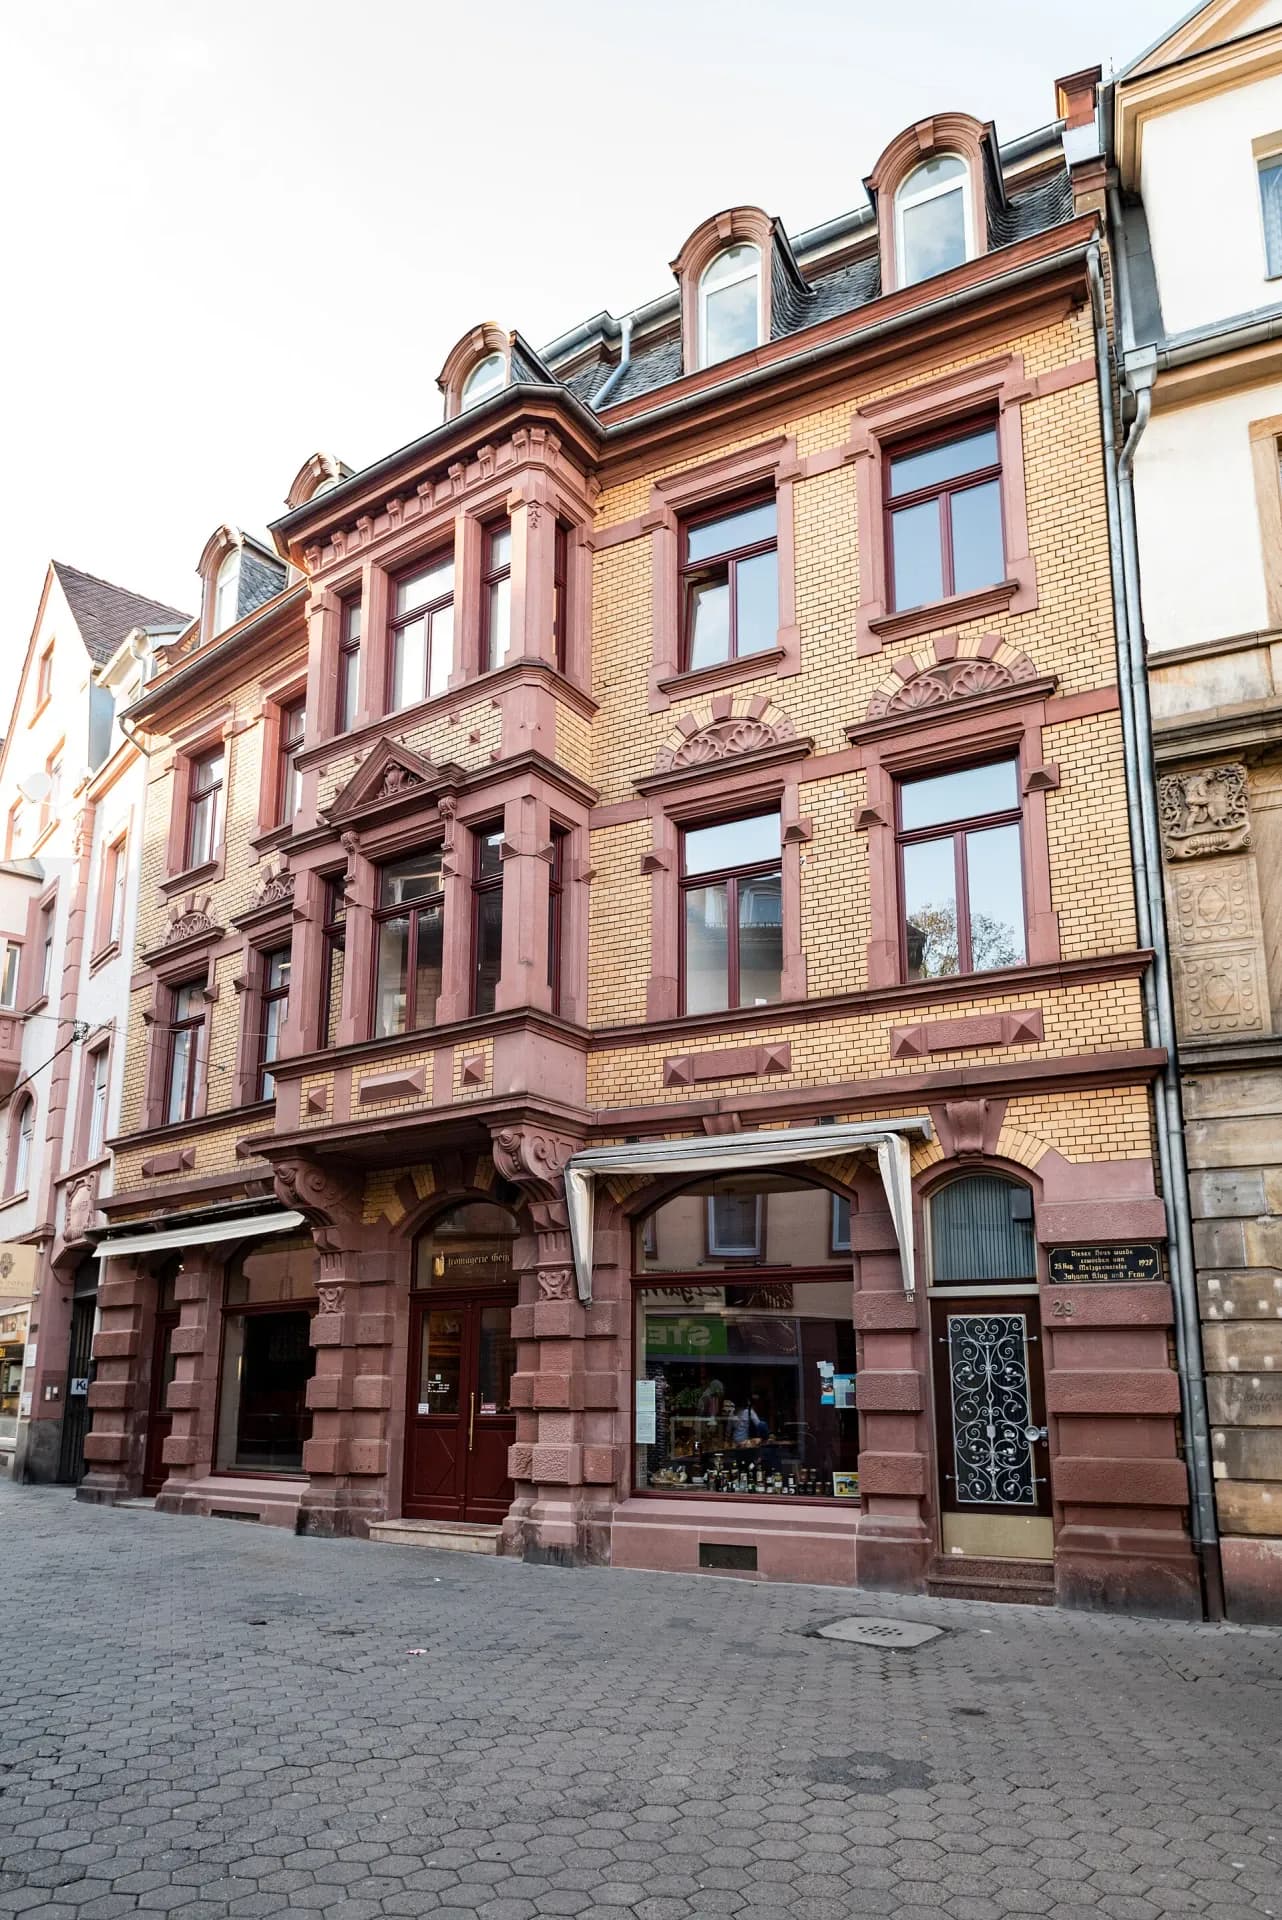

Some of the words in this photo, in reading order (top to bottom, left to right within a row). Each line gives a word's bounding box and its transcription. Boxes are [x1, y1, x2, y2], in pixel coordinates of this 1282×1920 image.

[1079, 1263, 1127, 1271] Metzgermeister
[1063, 1272, 1089, 1280] Johann
[1128, 1270, 1145, 1278] Frau
[1053, 1299, 1074, 1317] 29
